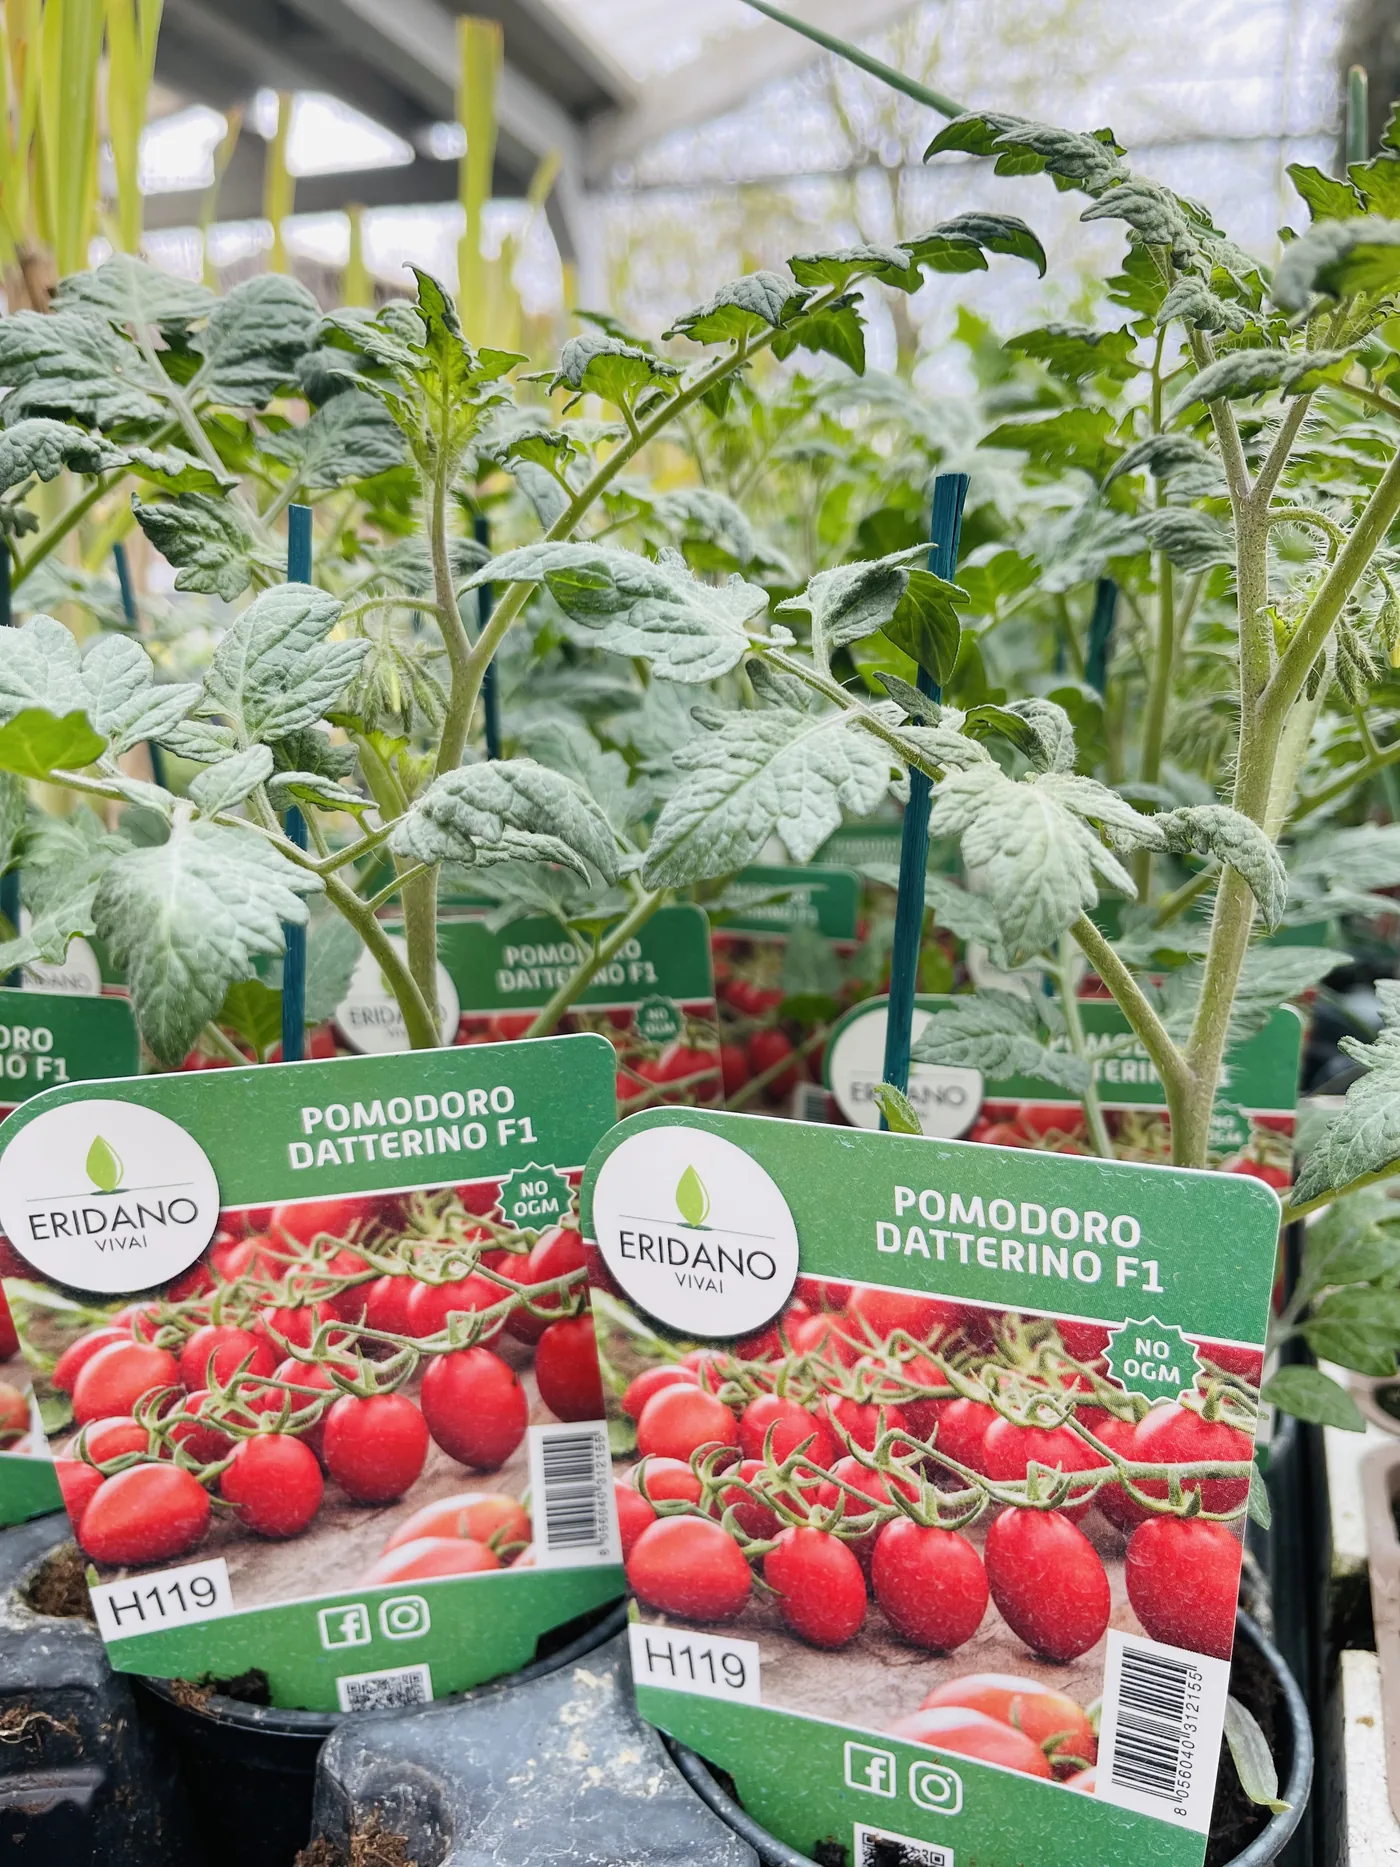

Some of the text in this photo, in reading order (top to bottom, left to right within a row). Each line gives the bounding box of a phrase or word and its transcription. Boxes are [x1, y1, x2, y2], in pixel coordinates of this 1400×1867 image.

[36, 1055, 70, 1082] F1
[302, 1086, 515, 1135] POMODORO
[288, 1116, 538, 1170] DATTERINO F1
[514, 1198, 560, 1216] OGM
[521, 1181, 548, 1197] NO
[29, 1198, 199, 1240] ERIDANO
[894, 1185, 1142, 1248] POMODORO
[95, 1234, 148, 1252] VIVAI
[619, 1230, 777, 1280] ERIDANO
[876, 1221, 1164, 1293] DATTERINO F1
[675, 1272, 723, 1293] VIVAI
[1135, 1338, 1170, 1359] NO
[1123, 1359, 1181, 1385] OGM
[109, 1576, 217, 1626] H119
[645, 1638, 746, 1689] H119
